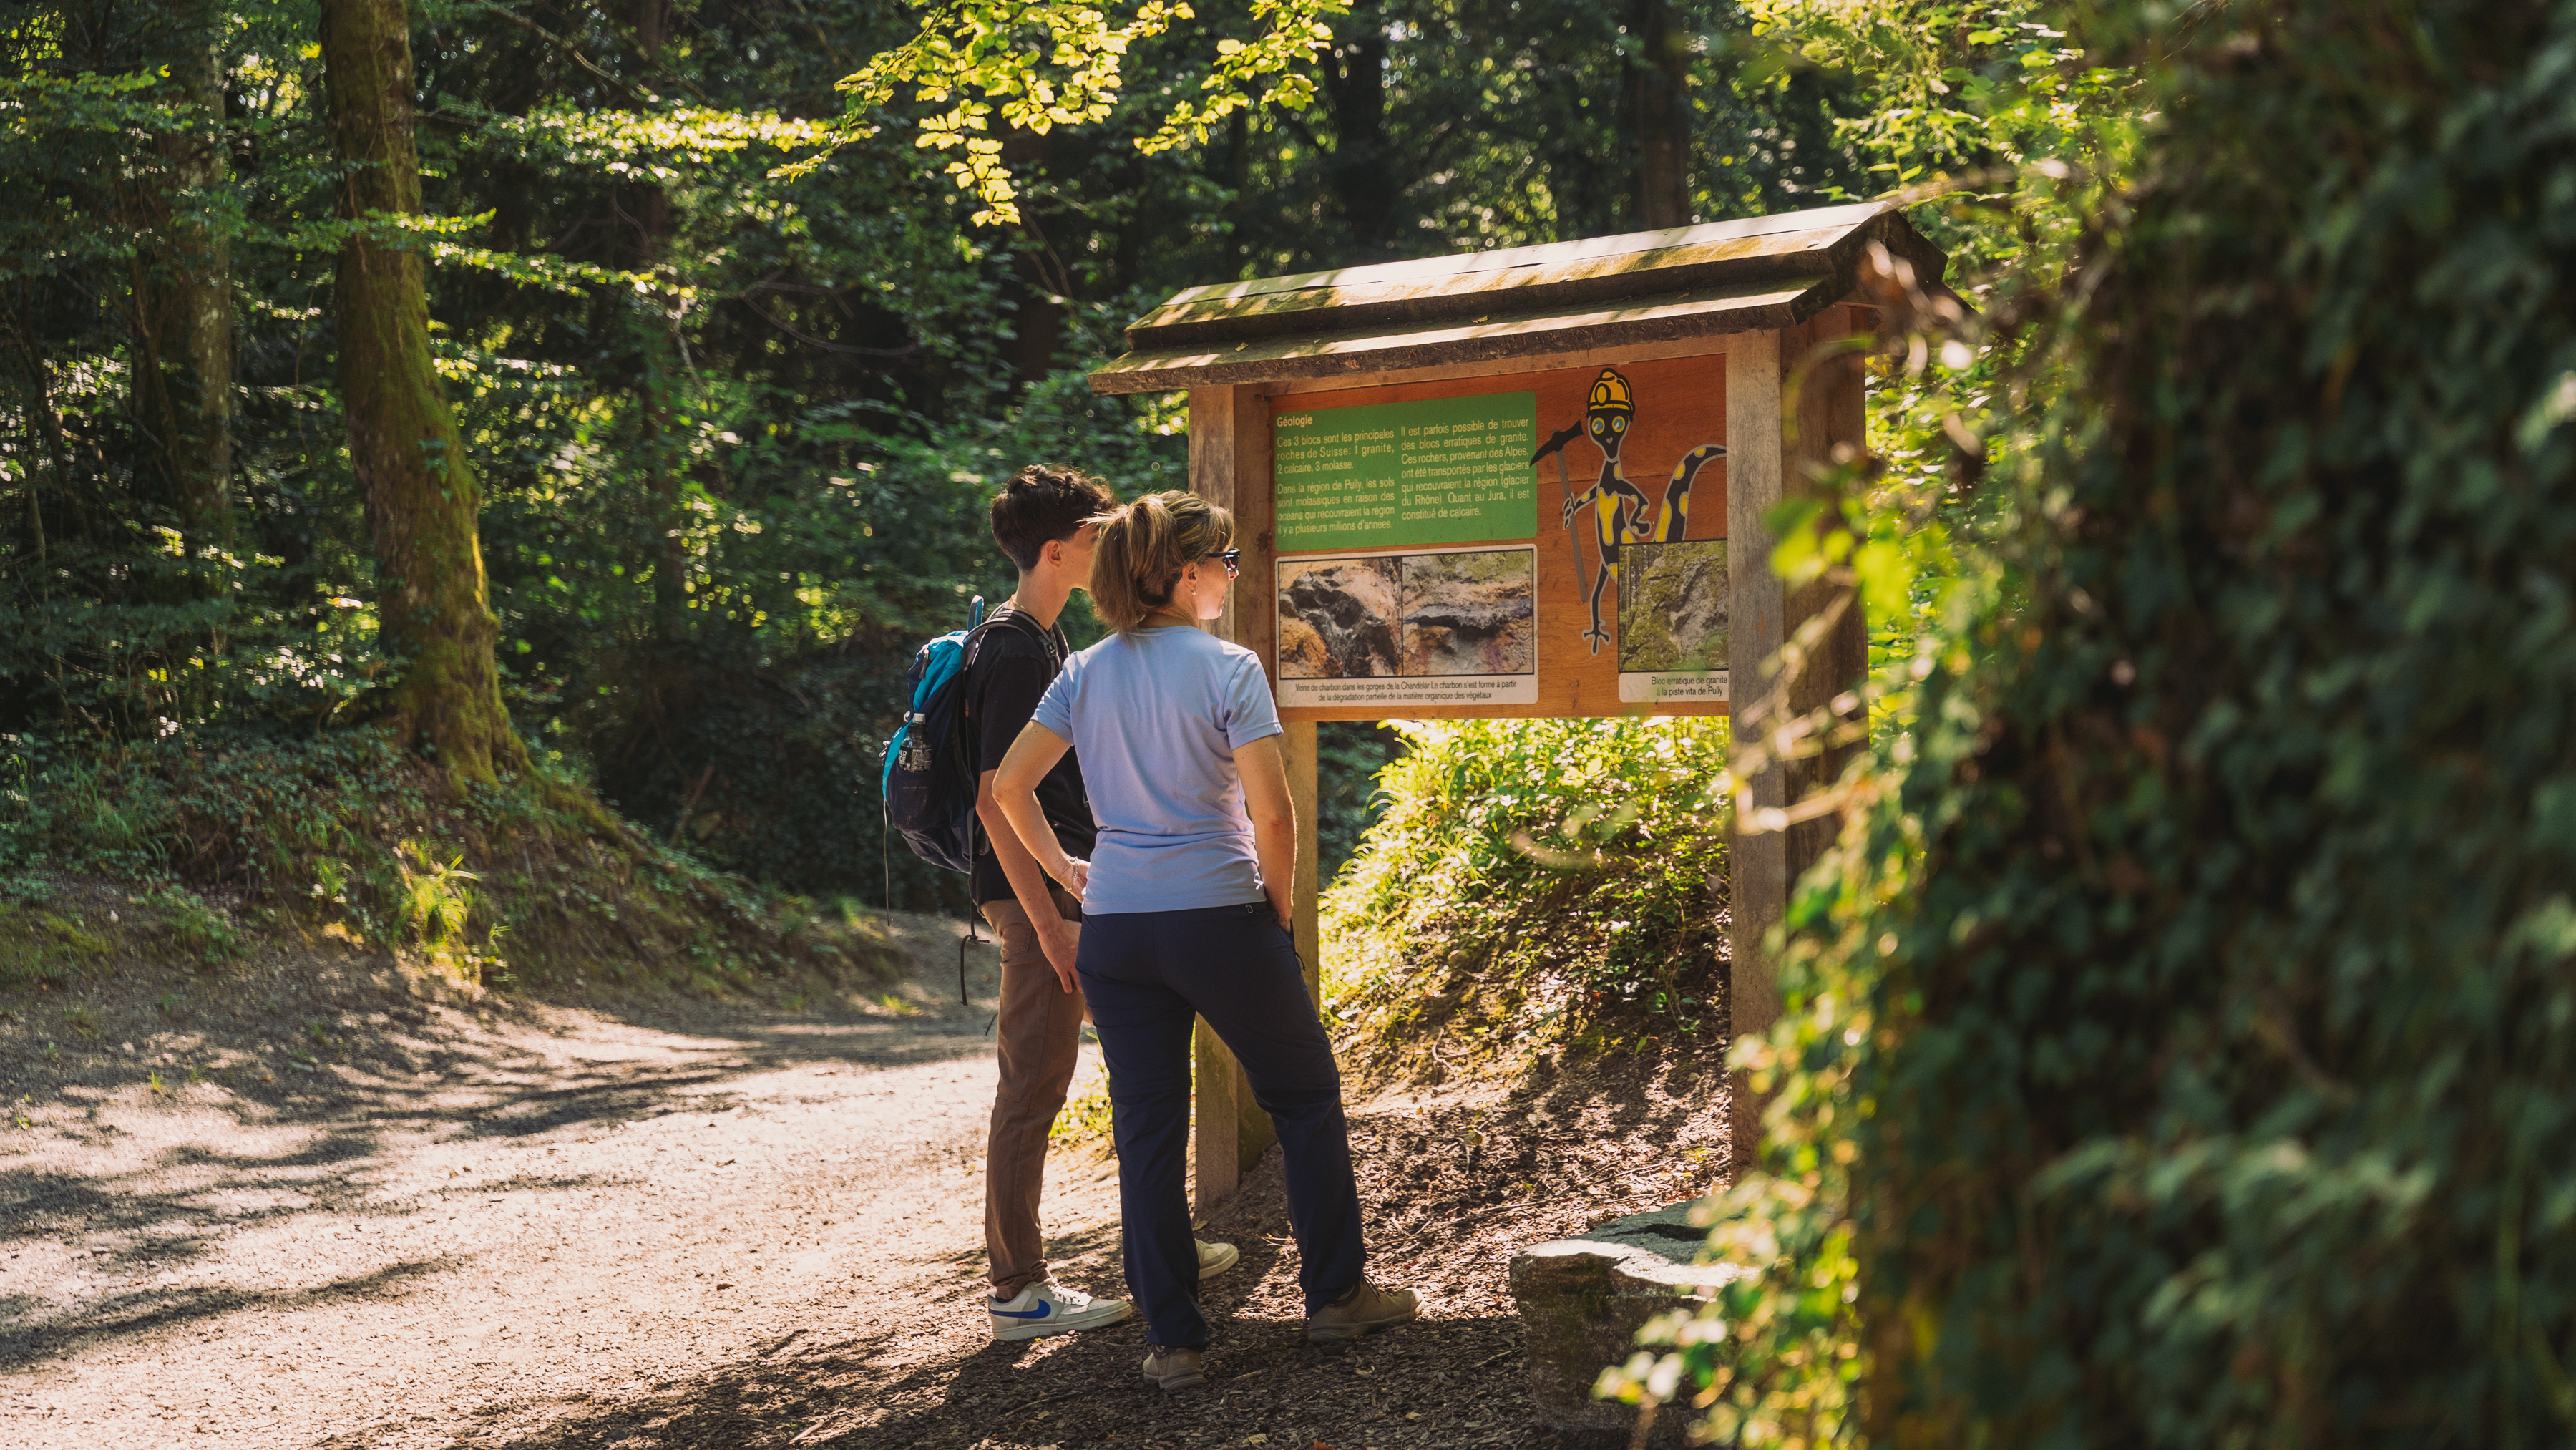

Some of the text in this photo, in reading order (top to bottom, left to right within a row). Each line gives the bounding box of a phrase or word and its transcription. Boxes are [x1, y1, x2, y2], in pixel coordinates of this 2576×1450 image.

[1277, 414, 1312, 428] Géologie
[1401, 419, 1528, 437] Il est parfois possible de trouver
[1277, 429, 1394, 447] Ces 3 blocs sont les principales
[1402, 431, 1528, 450] des blocs erratiques de granite.
[1277, 442, 1394, 461] roches de Suisse: 1 granite,
[1402, 446, 1529, 464] Ces rochers, provenant des Alpes,
[1277, 460, 1353, 474] 2 calcaire, 3 molasse.
[1402, 459, 1529, 478] ont été transportés par les glaciers
[1277, 476, 1395, 494] Dans la région de Pully, les sols
[1402, 474, 1529, 495] qui recouvraient la région (glacier
[1277, 498, 1292, 507] sont
[1296, 495, 1340, 507] molassiques
[1356, 492, 1377, 502] raison
[1381, 491, 1395, 501] des
[1402, 496, 1411, 506] du
[1415, 492, 1444, 505] Rhône).
[1448, 492, 1471, 503] Quant
[1488, 490, 1506, 501] Jura,
[1510, 489, 1513, 499] il
[1518, 490, 1529, 499] est
[1278, 504, 1395, 522] océans qui recouvraient la région
[1402, 505, 1481, 520] constitué de calcaire.
[1278, 525, 1281, 534] il
[1283, 527, 1287, 537] y
[1295, 522, 1327, 536] plusieurs
[1329, 520, 1356, 531] millions
[1342, 682, 1355, 691] dans
[1366, 683, 1385, 692] gorges
[1502, 680, 1516, 689] partir
[1652, 676, 1665, 685] Bloc
[1667, 676, 1694, 686] erratique
[1707, 676, 1727, 686] granite
[1333, 692, 1364, 702] dégradation
[1366, 692, 1387, 701] partielle
[1425, 691, 1453, 701] organique
[1466, 691, 1491, 701] végétaux
[1669, 687, 1684, 697] piste
[1708, 686, 1722, 696] Pully
